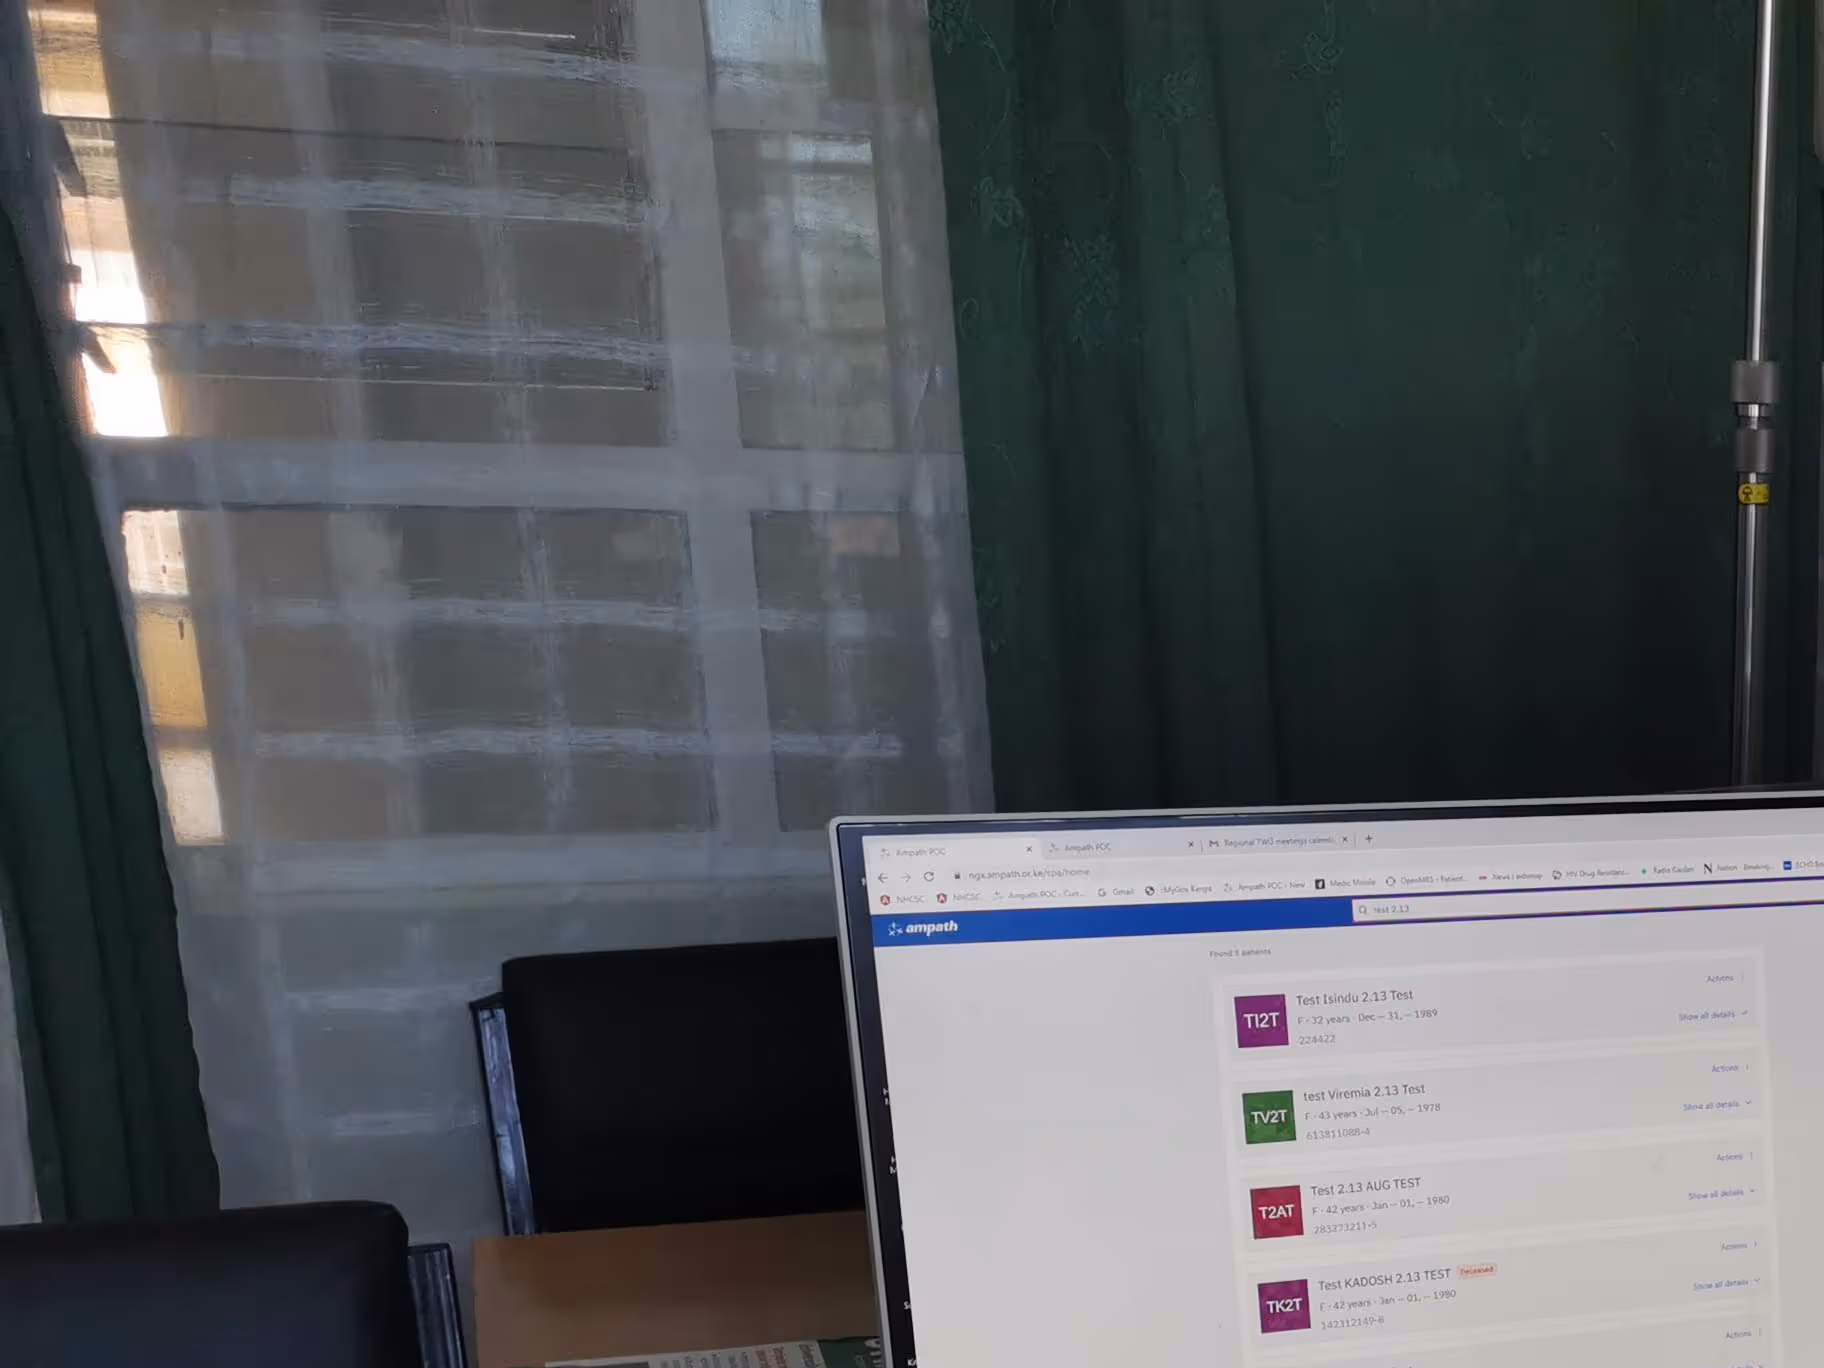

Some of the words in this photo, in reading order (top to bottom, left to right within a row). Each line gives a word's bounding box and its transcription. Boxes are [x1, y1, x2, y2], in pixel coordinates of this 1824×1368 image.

[905, 920, 959, 938] ampath
[1296, 995, 1320, 1007] Test
[1322, 993, 1359, 1005] Isindu
[1361, 991, 1388, 1003] 2.13
[1390, 989, 1413, 1001] Test
[1243, 1012, 1281, 1028] TI2T
[1326, 1015, 1350, 1026] years
[1304, 1091, 1325, 1102] test
[1328, 1088, 1371, 1100] Viremia
[1374, 1085, 1400, 1097] 2.13
[1402, 1083, 1426, 1095] Test
[1251, 1109, 1288, 1125] TV2T
[1334, 1110, 1358, 1121] years
[1310, 1185, 1335, 1197] Test
[1337, 1182, 1363, 1194] 2.13
[1365, 1179, 1392, 1192] AUG
[1393, 1177, 1422, 1189] TEST
[1258, 1204, 1295, 1220] T2AT
[1340, 1204, 1365, 1216] years
[1318, 1280, 1342, 1292] Test
[1344, 1275, 1393, 1289] KADOSH
[1396, 1272, 1420, 1285] 2.13
[1424, 1268, 1451, 1281] TEST
[1266, 1297, 1303, 1314] TK2T
